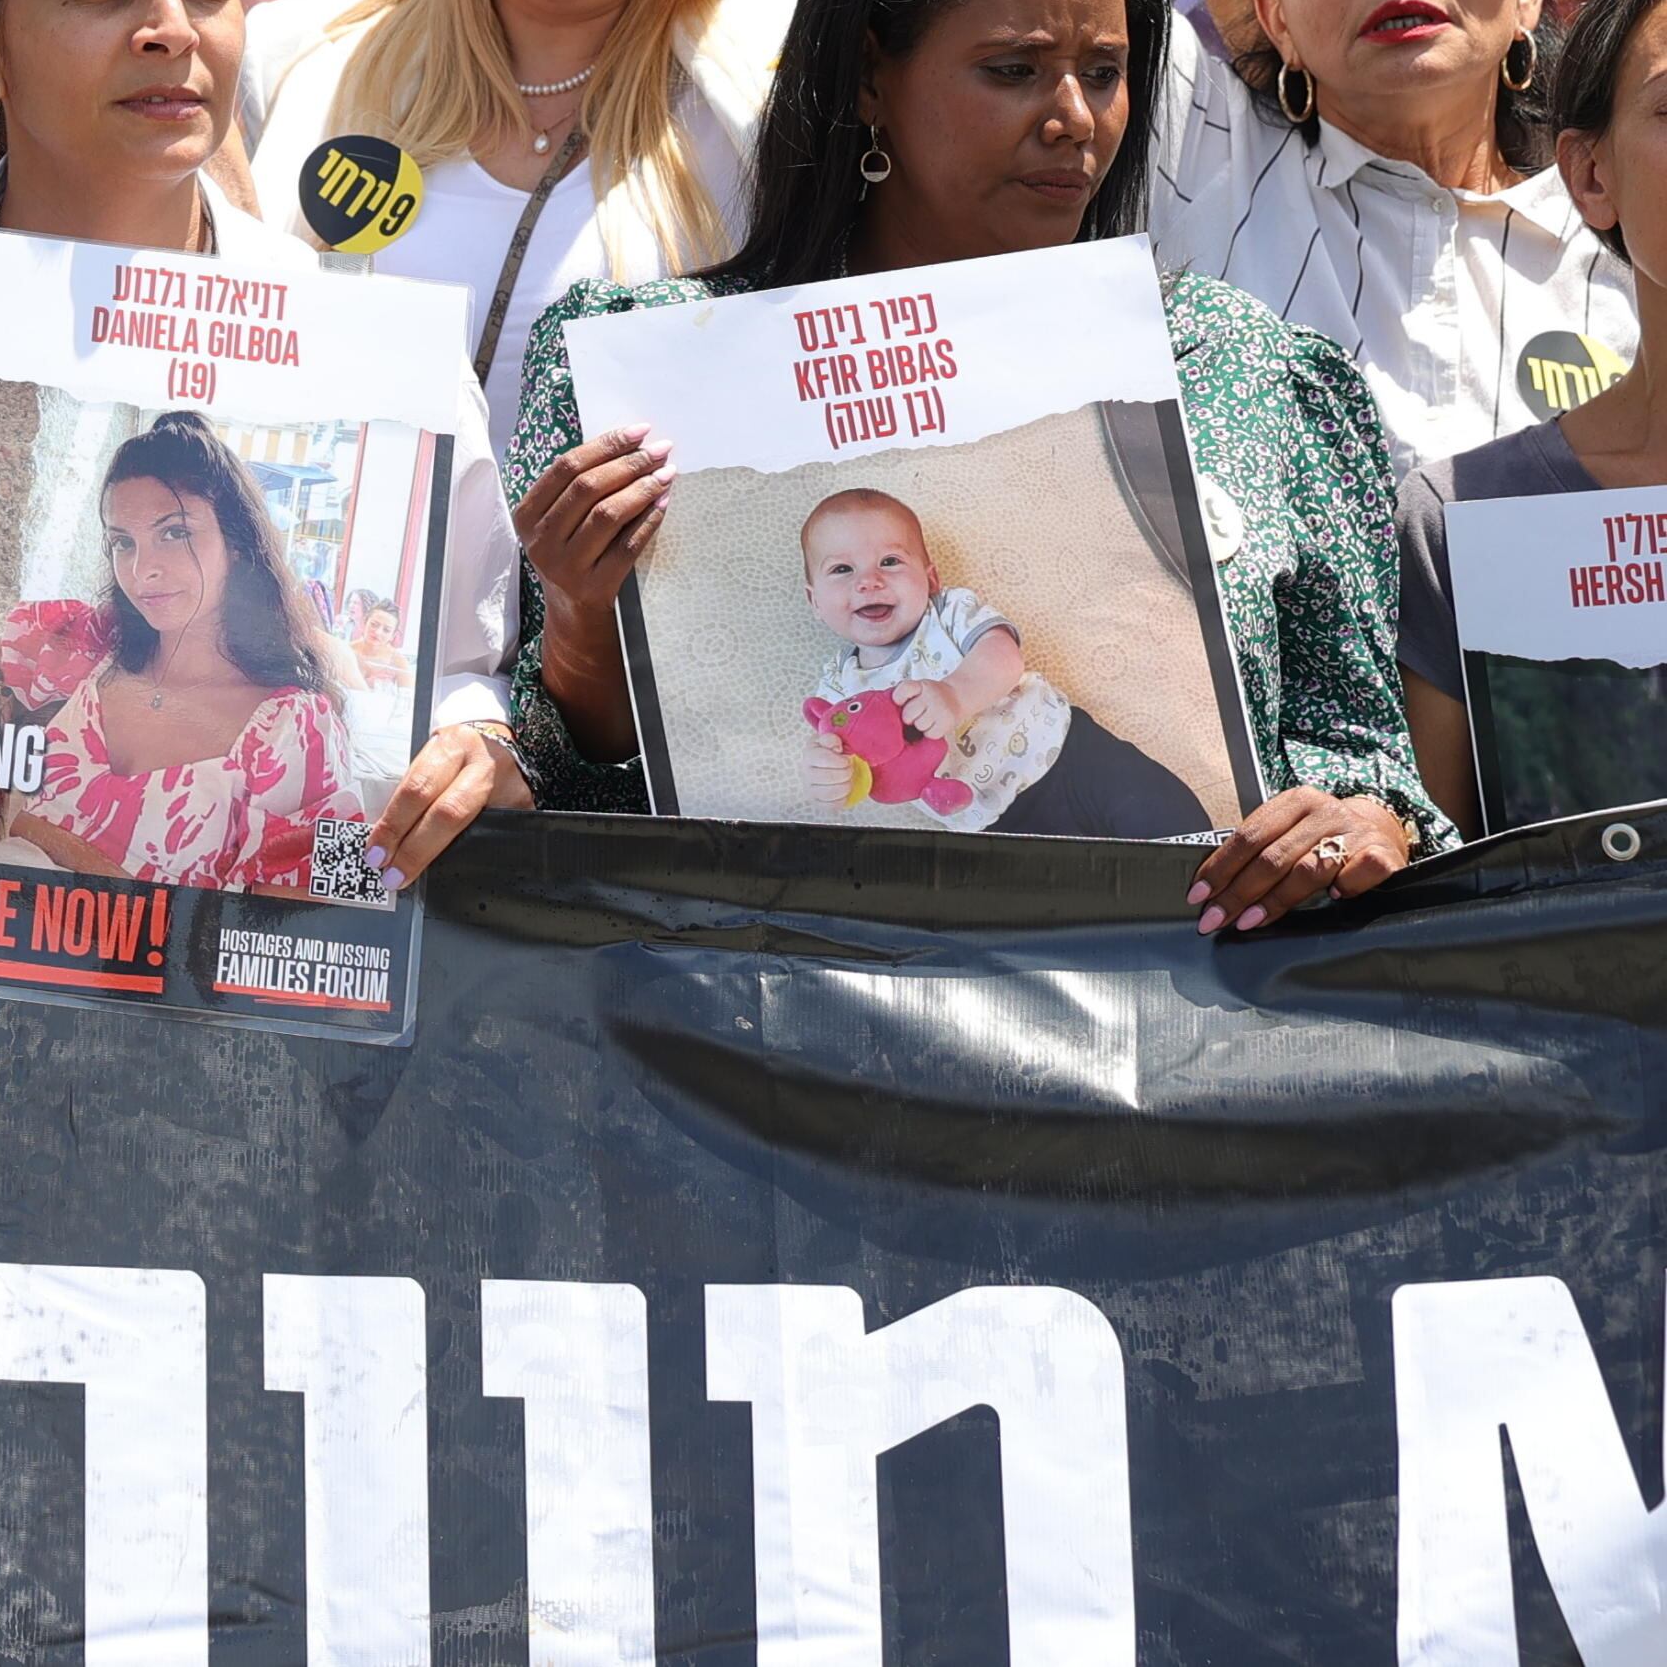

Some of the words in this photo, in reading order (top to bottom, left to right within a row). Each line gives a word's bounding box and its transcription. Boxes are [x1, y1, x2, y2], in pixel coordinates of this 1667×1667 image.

[379, 193, 416, 236] 9
[112, 265, 189, 310] גלבוע
[196, 277, 289, 321] דניאלה
[90, 307, 199, 356] DANIELA
[208, 319, 301, 368] GILBOA
[794, 303, 866, 352] ביבס
[869, 293, 938, 340] כפיר
[166, 358, 217, 406] (19)
[793, 353, 862, 402] KFIR
[866, 338, 958, 390] BIBAS
[1569, 562, 1666, 608] HERSH
[31, 884, 170, 967] NOW!
[219, 928, 293, 961] HOSTAGES
[294, 938, 324, 964] AND
[325, 941, 391, 972] MISSING
[216, 951, 312, 995] FAMILIES
[316, 963, 390, 1004] FORUM
